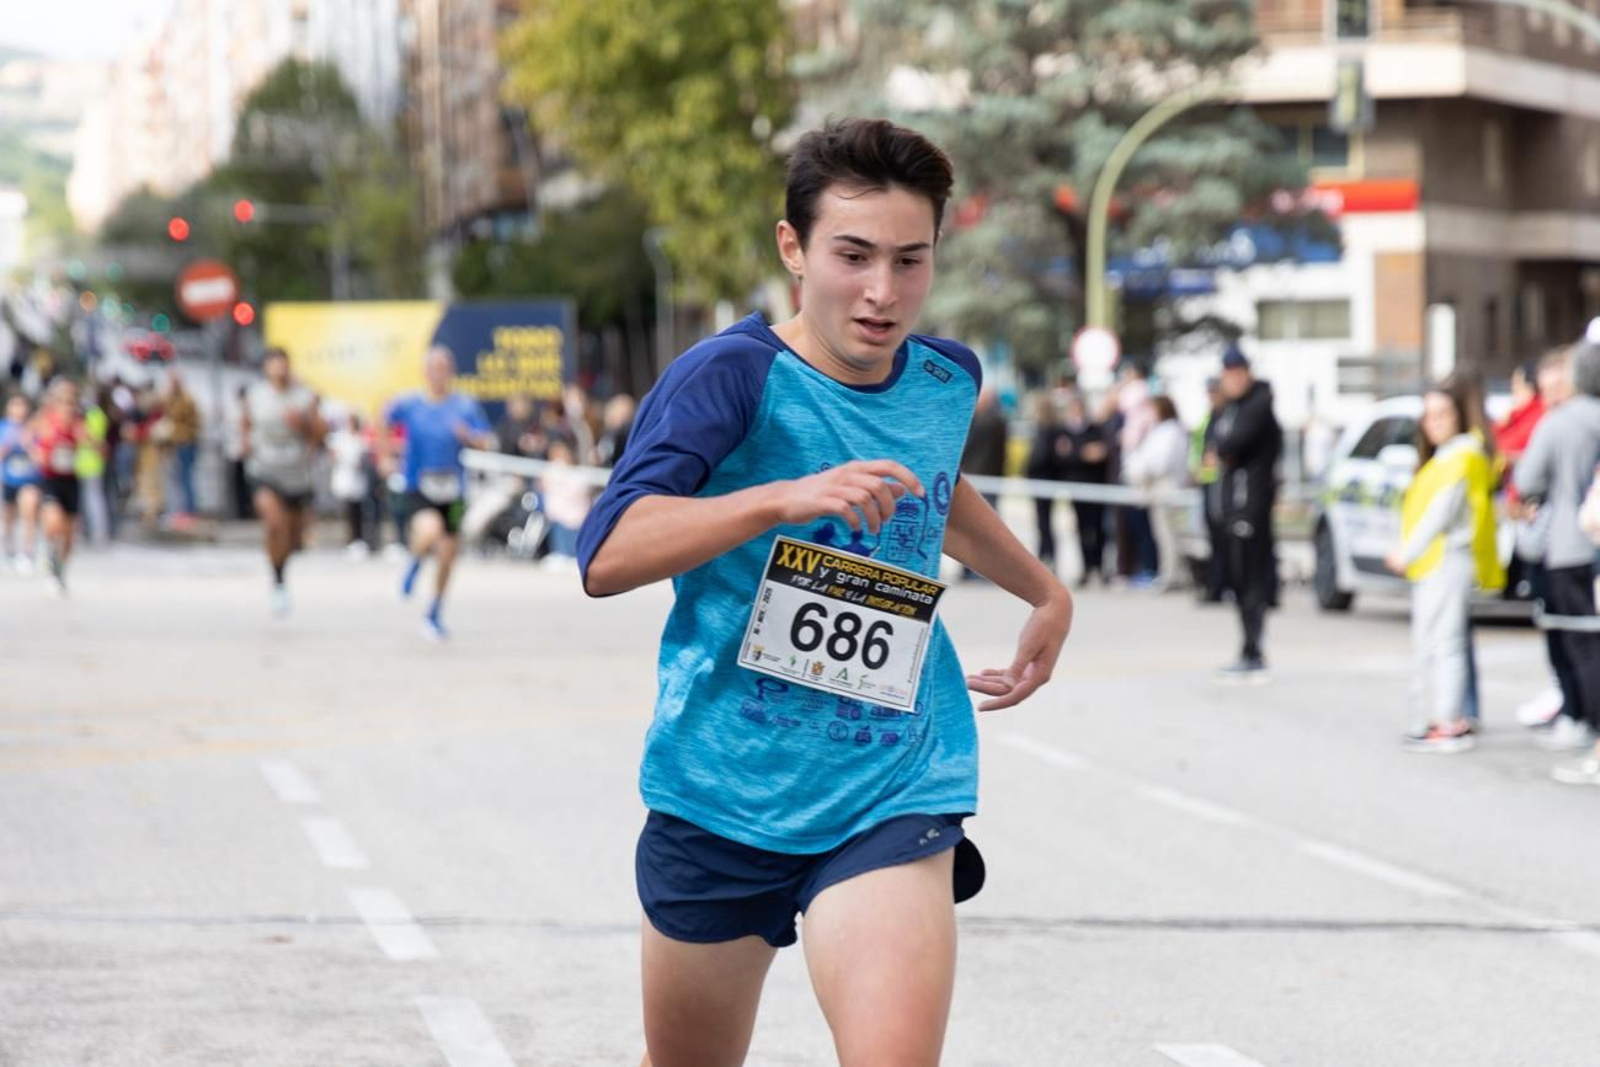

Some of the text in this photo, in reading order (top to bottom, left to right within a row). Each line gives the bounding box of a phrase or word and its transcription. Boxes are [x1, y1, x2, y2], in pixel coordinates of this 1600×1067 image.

[777, 544, 821, 573] XXV
[822, 556, 939, 595] CARRERA POPULAR
[811, 581, 828, 593] LA
[818, 566, 934, 605] y gran caminata
[790, 602, 894, 670] 686
